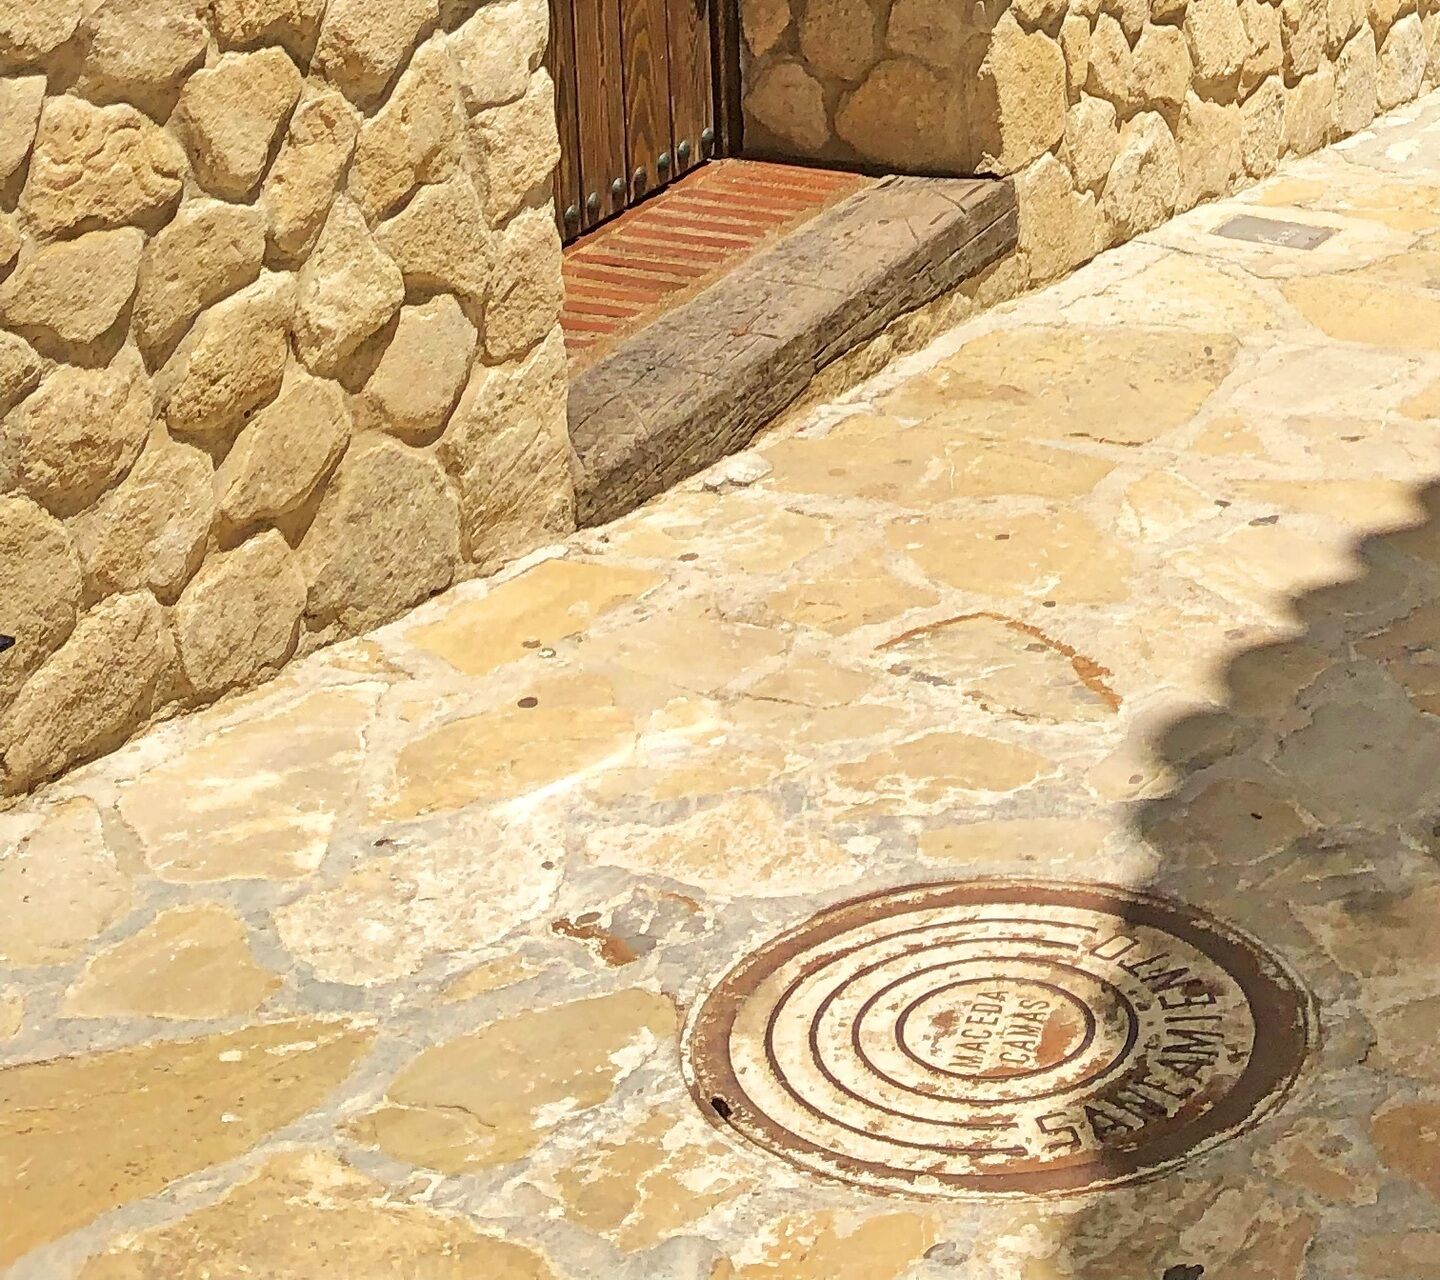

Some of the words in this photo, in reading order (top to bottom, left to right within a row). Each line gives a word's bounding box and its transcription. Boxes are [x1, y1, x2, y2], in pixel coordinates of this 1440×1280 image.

[948, 990, 1010, 1070] MACEDA
[998, 999, 1050, 1065] CAMAS
[1034, 934, 1225, 1147] SANEAMIENTO
